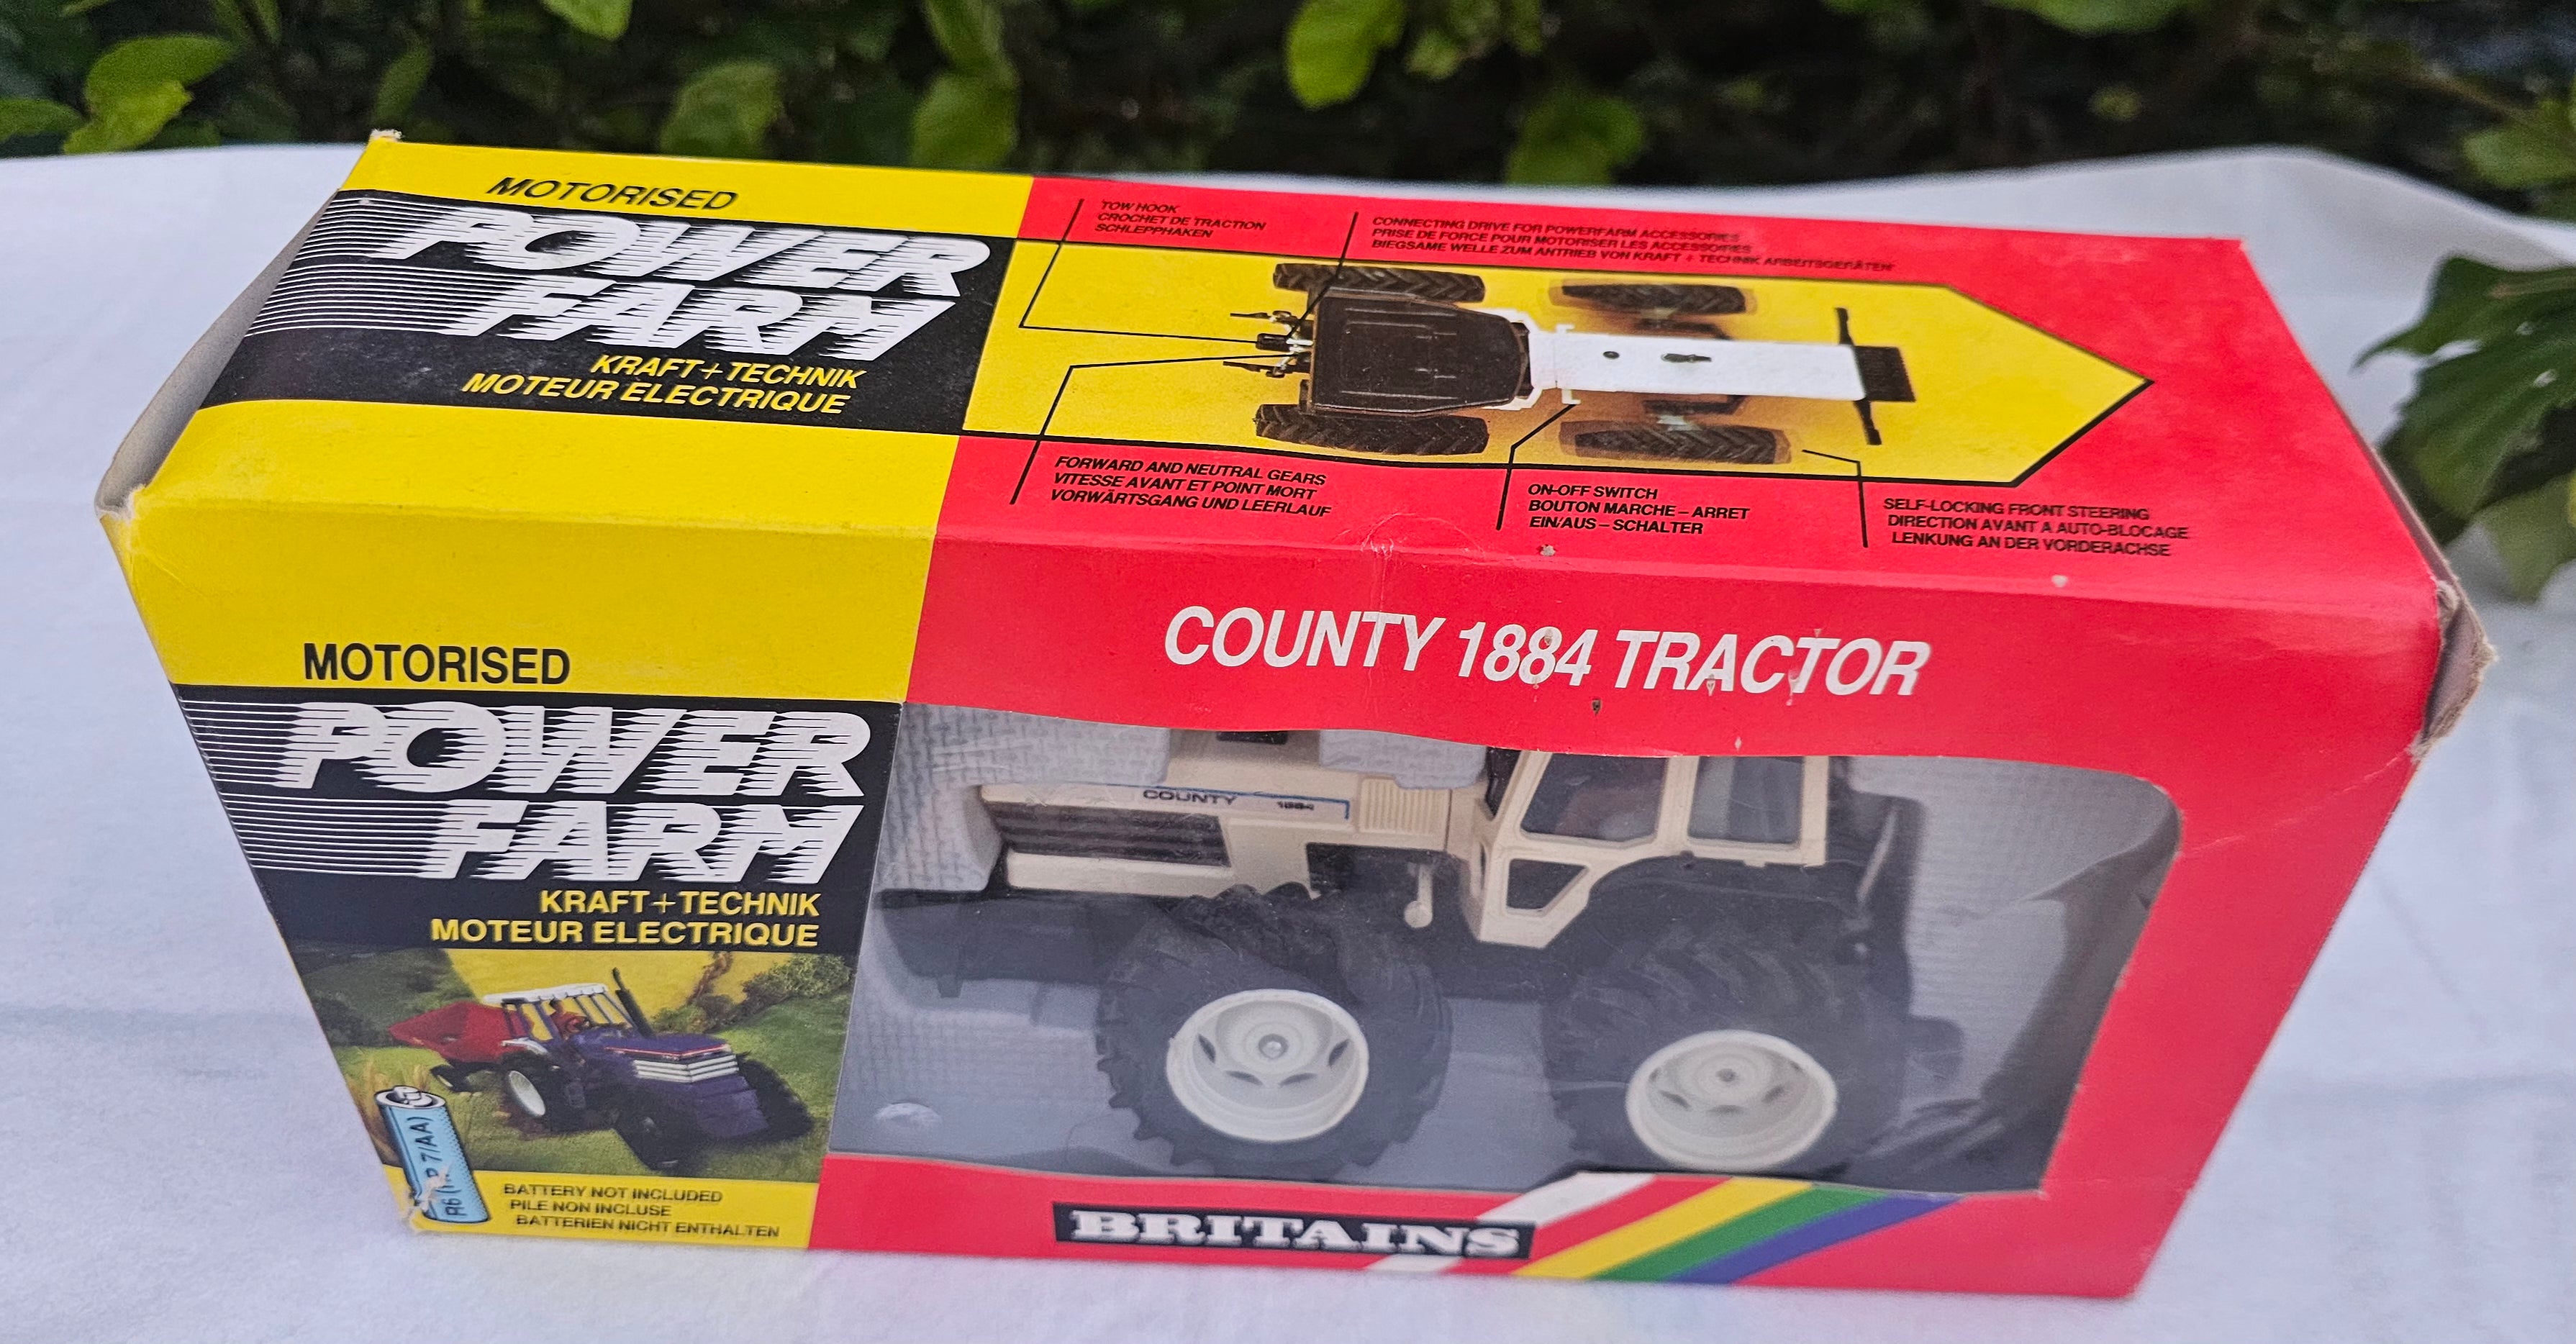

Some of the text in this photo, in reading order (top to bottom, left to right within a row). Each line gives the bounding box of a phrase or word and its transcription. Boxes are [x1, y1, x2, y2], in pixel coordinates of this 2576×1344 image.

[486, 177, 739, 212] MOTORISED
[1100, 200, 1178, 214] TOW HOOK
[1094, 224, 1213, 238] SCHLEPPHAKEN
[1097, 213, 1266, 230] CROCHET DE TRACTION
[1372, 217, 1465, 230] CONNECTING
[1467, 221, 1509, 232] DRIVE
[1513, 223, 1542, 233] FOR
[1545, 225, 1637, 237] POWERFARM
[369, 206, 991, 297] POWER
[1372, 228, 1415, 238] PRISE
[1416, 230, 1436, 240] DE
[1439, 232, 1488, 242] FORCE
[1490, 234, 1531, 243] POUR
[1535, 236, 1618, 248] MOTORISER
[1620, 240, 1648, 250] LES
[1371, 240, 1448, 251] BIEGSAME
[1451, 243, 1499, 253] WELLE
[1501, 245, 1532, 255] ZUM
[1534, 248, 1597, 258] ANTRIEB
[1600, 250, 1630, 260] VON
[1633, 252, 1682, 262] KRAFT
[1700, 254, 1760, 265] TECHNIK
[435, 276, 956, 361] FARM
[461, 373, 851, 414] MOTEUR ELECTRIQUE
[1055, 456, 1327, 486] FORWARD AND NEUTRAL GEARS
[1054, 473, 1318, 499] VITESSE AVANT ET POINT MORT
[1593, 486, 1658, 500] SWITCH
[1051, 489, 1332, 517] VORWÄRTSGANG UND LEERLAUF
[1528, 500, 1601, 514] BOUTON
[1603, 503, 1677, 517] MARCHE
[1691, 507, 1750, 519] ARRET
[1883, 498, 2149, 520] SELF-LOCKING FRONT STEERING
[1529, 517, 1597, 530] EIN/AUS
[1612, 519, 1703, 535] SCHALTER
[1888, 514, 2189, 540] DIRECTION AVANT A AUTO-BLOCAGE
[1892, 532, 2172, 557] LENKUNG AN DER VORDERACHSE
[1164, 606, 1931, 697] COUNTY 1884 TRACTOR
[303, 643, 571, 686] MOTORISED
[272, 701, 872, 797] POWER
[1143, 789, 1237, 805] COUNTY
[419, 797, 864, 884] FARM
[432, 917, 819, 947] MOTEUR ELECTRIQUE
[504, 1183, 722, 1203] BATTERY NOT INCLUDED
[510, 1199, 672, 1217] PILE NON INCLUSE
[516, 1214, 780, 1238] BATTERIEN NICHT ENTHALTEN
[1071, 1209, 1521, 1257] BRITAINS
